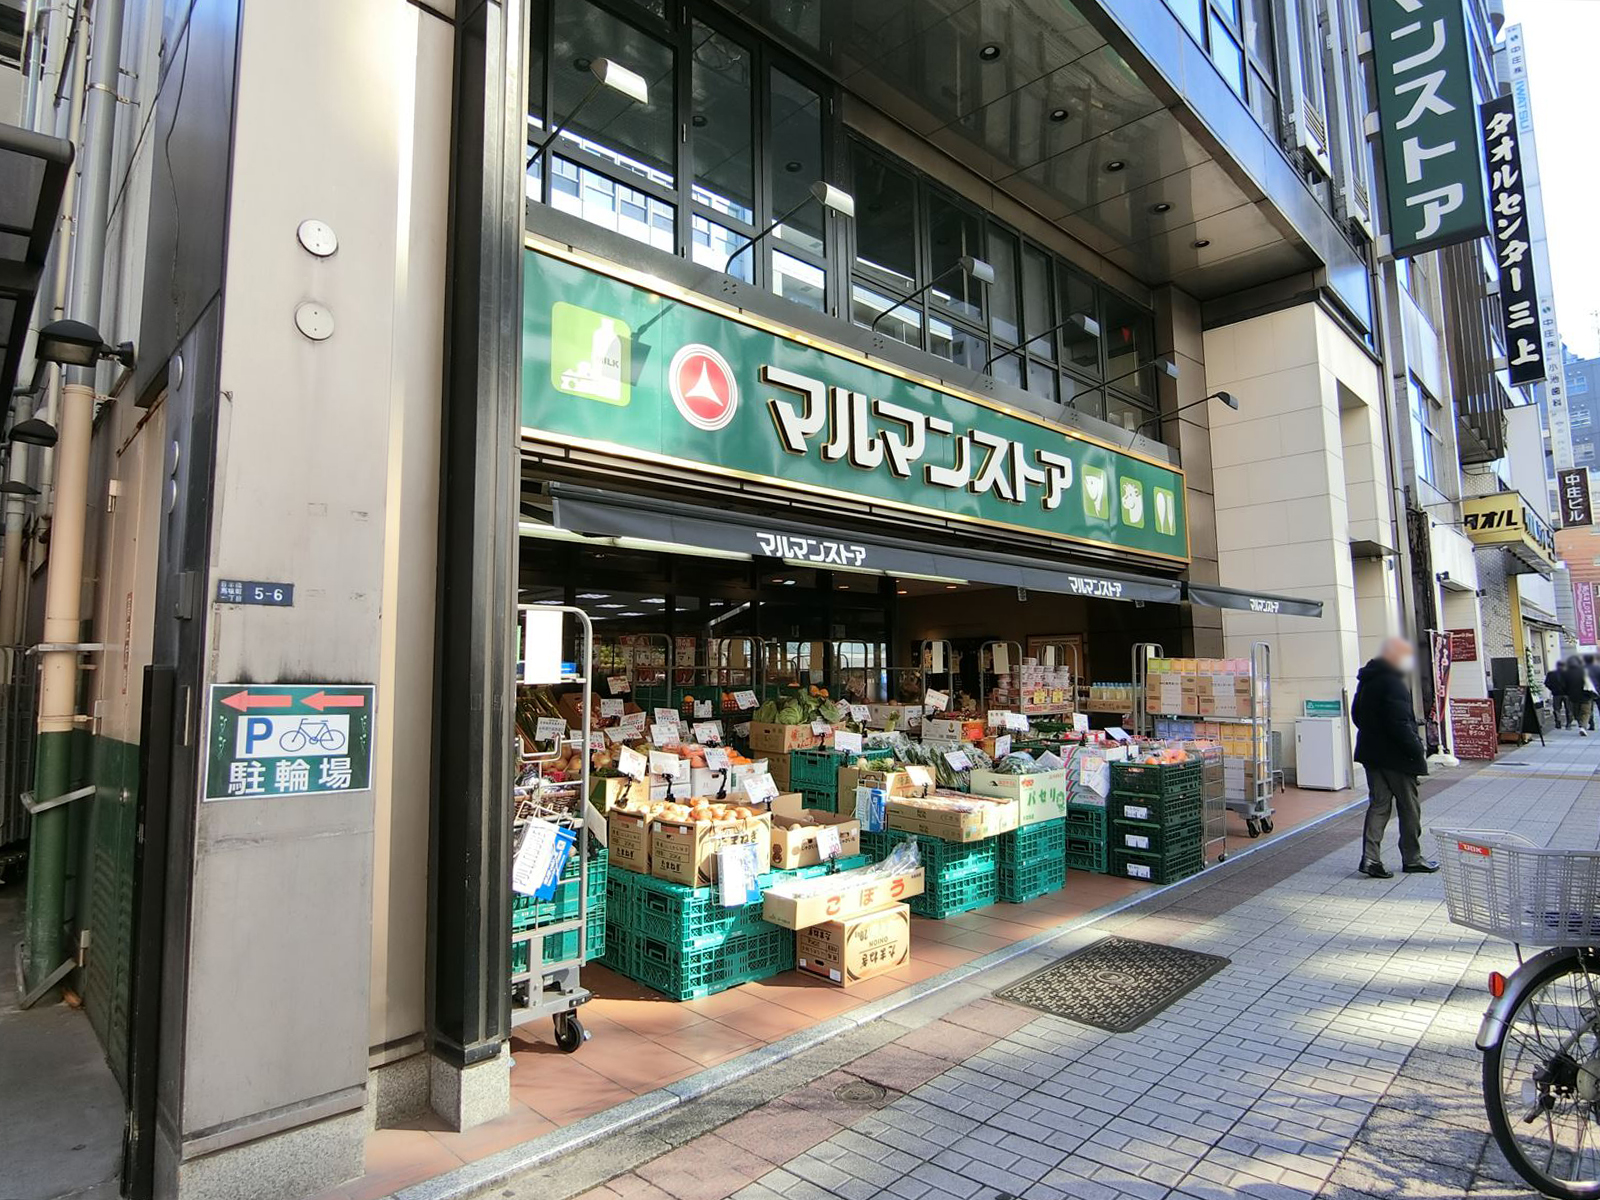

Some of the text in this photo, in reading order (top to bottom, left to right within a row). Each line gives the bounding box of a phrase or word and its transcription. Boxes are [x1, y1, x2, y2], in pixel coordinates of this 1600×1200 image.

[1514, 80, 1530, 130] IWATSU
[759, 365, 1074, 511] マルマンストア
[1564, 474, 1585, 522] 中庄ビル
[755, 532, 867, 567] マルマンストア
[254, 587, 284, 601] 5-6
[1067, 577, 1123, 598] マルマンストア
[245, 717, 273, 755] P
[228, 757, 353, 795] 駐輪場
[660, 860, 682, 873] たまねぎ
[860, 944, 896, 968] たまねぎ
[868, 936, 889, 947] ONION
